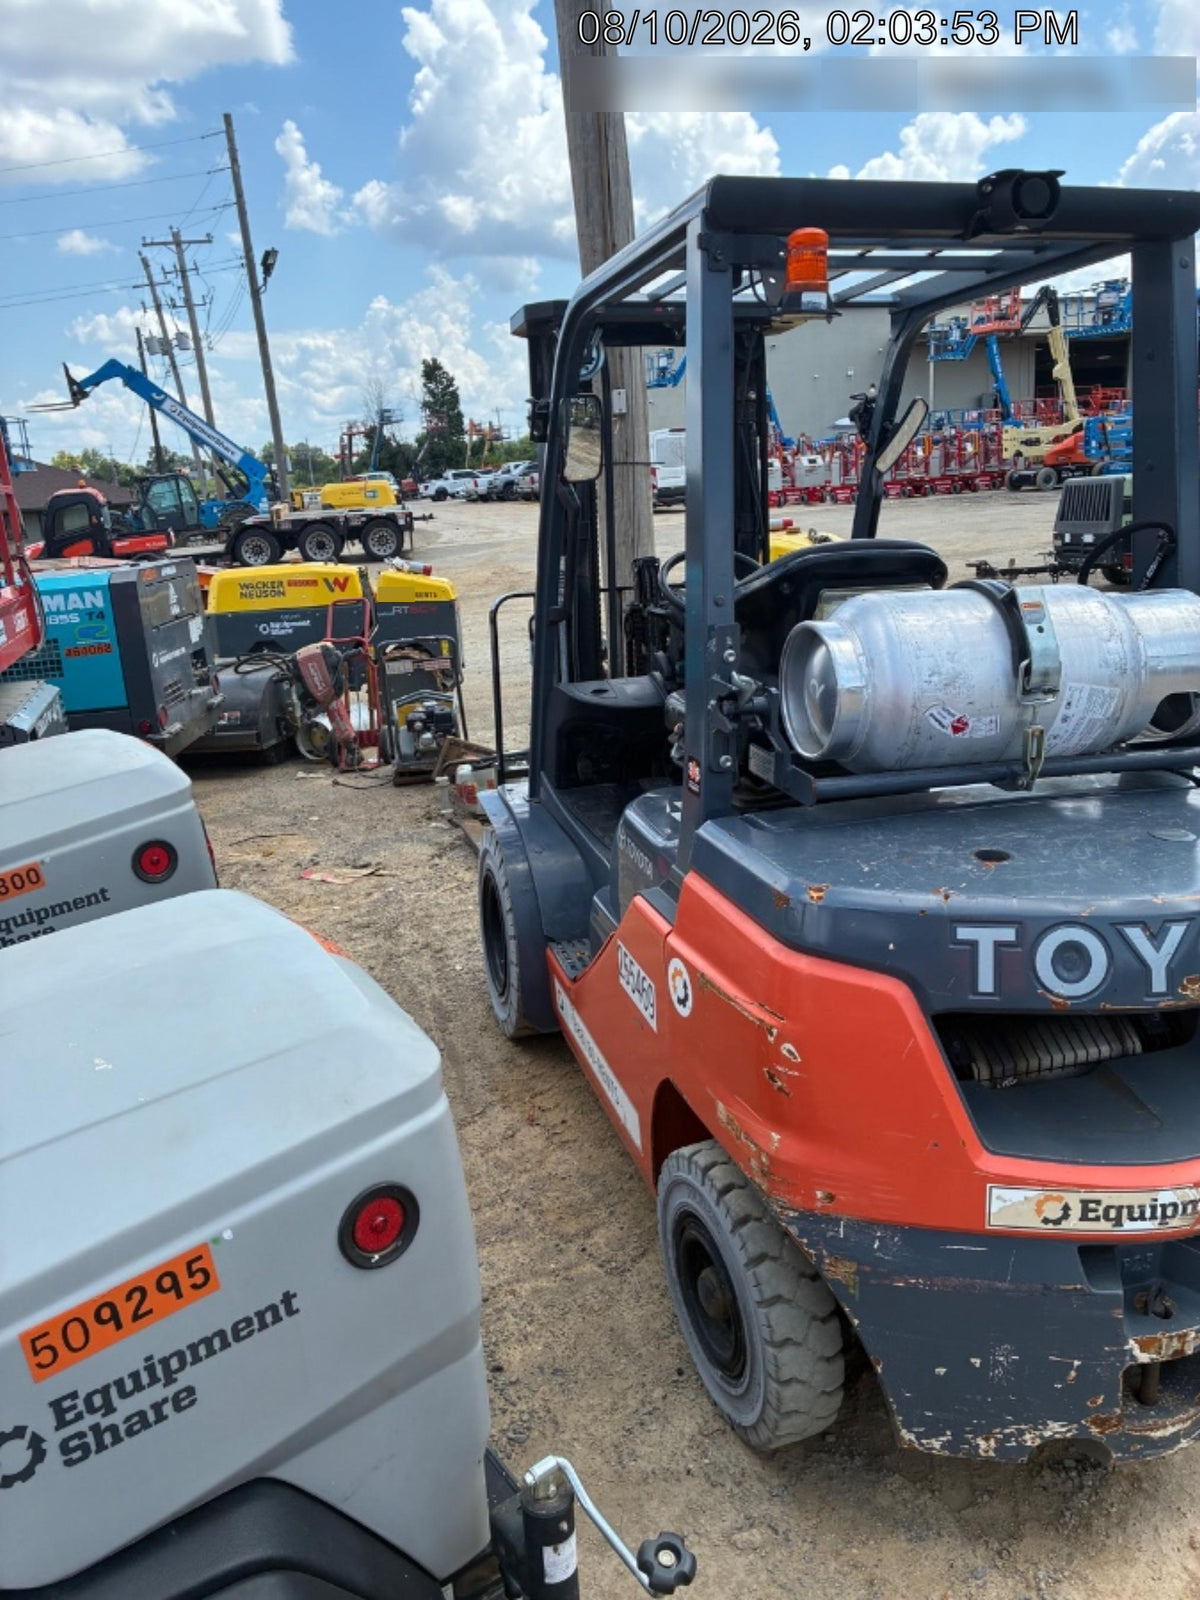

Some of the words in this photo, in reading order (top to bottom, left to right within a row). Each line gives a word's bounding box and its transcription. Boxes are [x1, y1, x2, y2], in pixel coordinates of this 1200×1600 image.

[238, 579, 285, 591] WACKER
[239, 587, 286, 599] NEUSON
[30, 1254, 212, 1370] 509295
[48, 1289, 300, 1432] Equipment
[58, 1383, 198, 1468] Share
